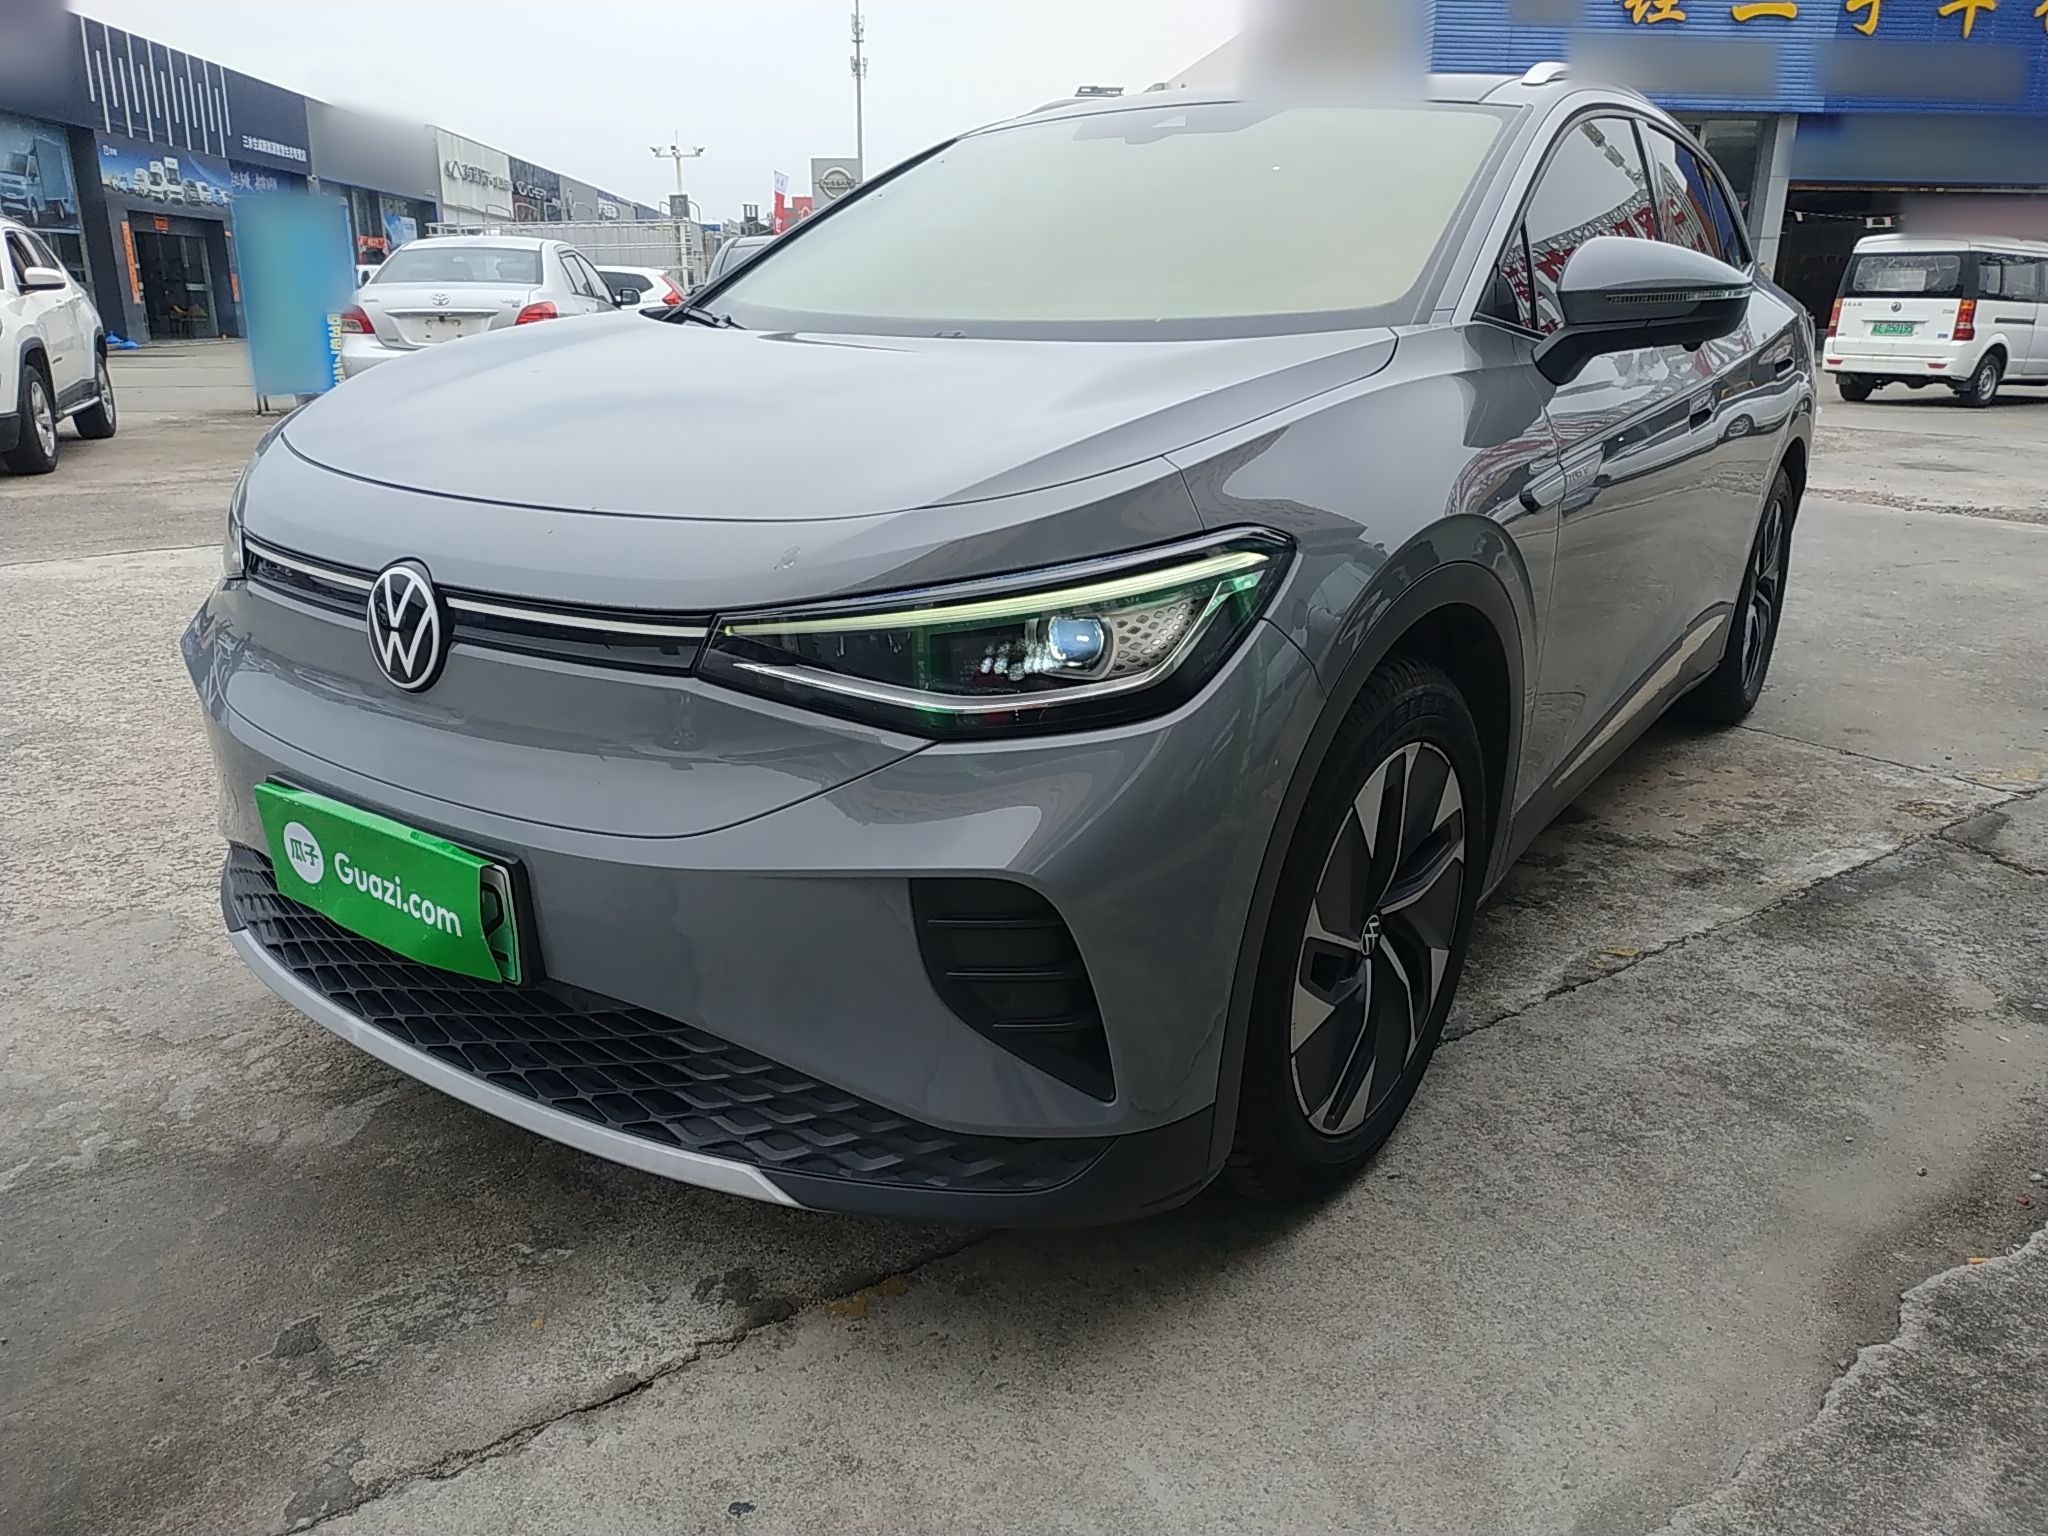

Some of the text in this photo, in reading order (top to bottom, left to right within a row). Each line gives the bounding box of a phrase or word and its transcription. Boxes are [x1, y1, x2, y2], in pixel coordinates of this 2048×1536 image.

[822, 179, 853, 188] NISSAN
[289, 837, 320, 867] 瓜子
[334, 852, 463, 938] Guazi.com
